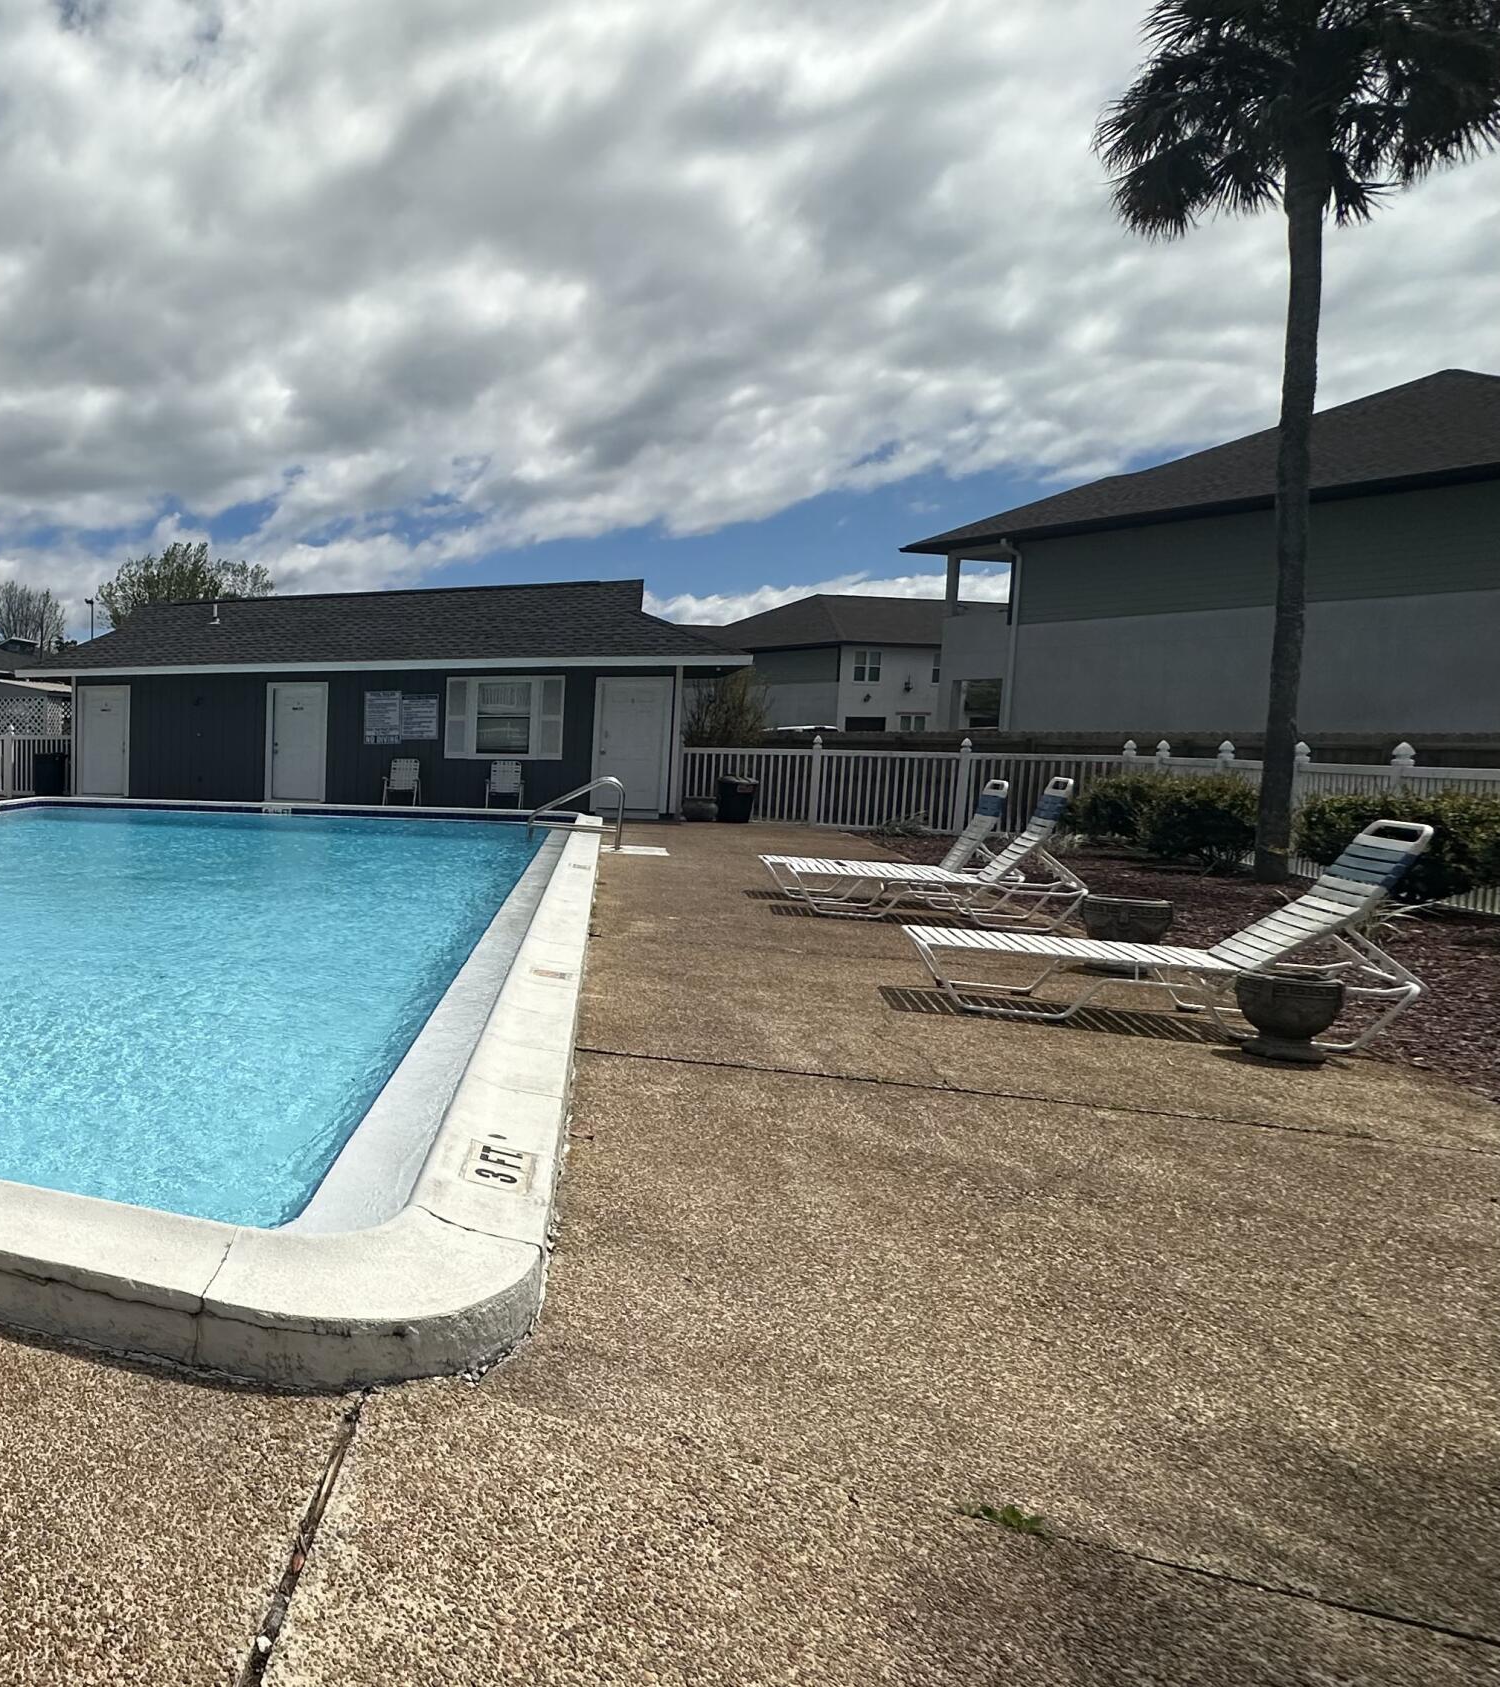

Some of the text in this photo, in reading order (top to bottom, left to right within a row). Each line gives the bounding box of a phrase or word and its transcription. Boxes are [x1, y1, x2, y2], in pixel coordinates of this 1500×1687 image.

[365, 735, 399, 743] NO DIVING
[475, 1168, 518, 1184] 3
